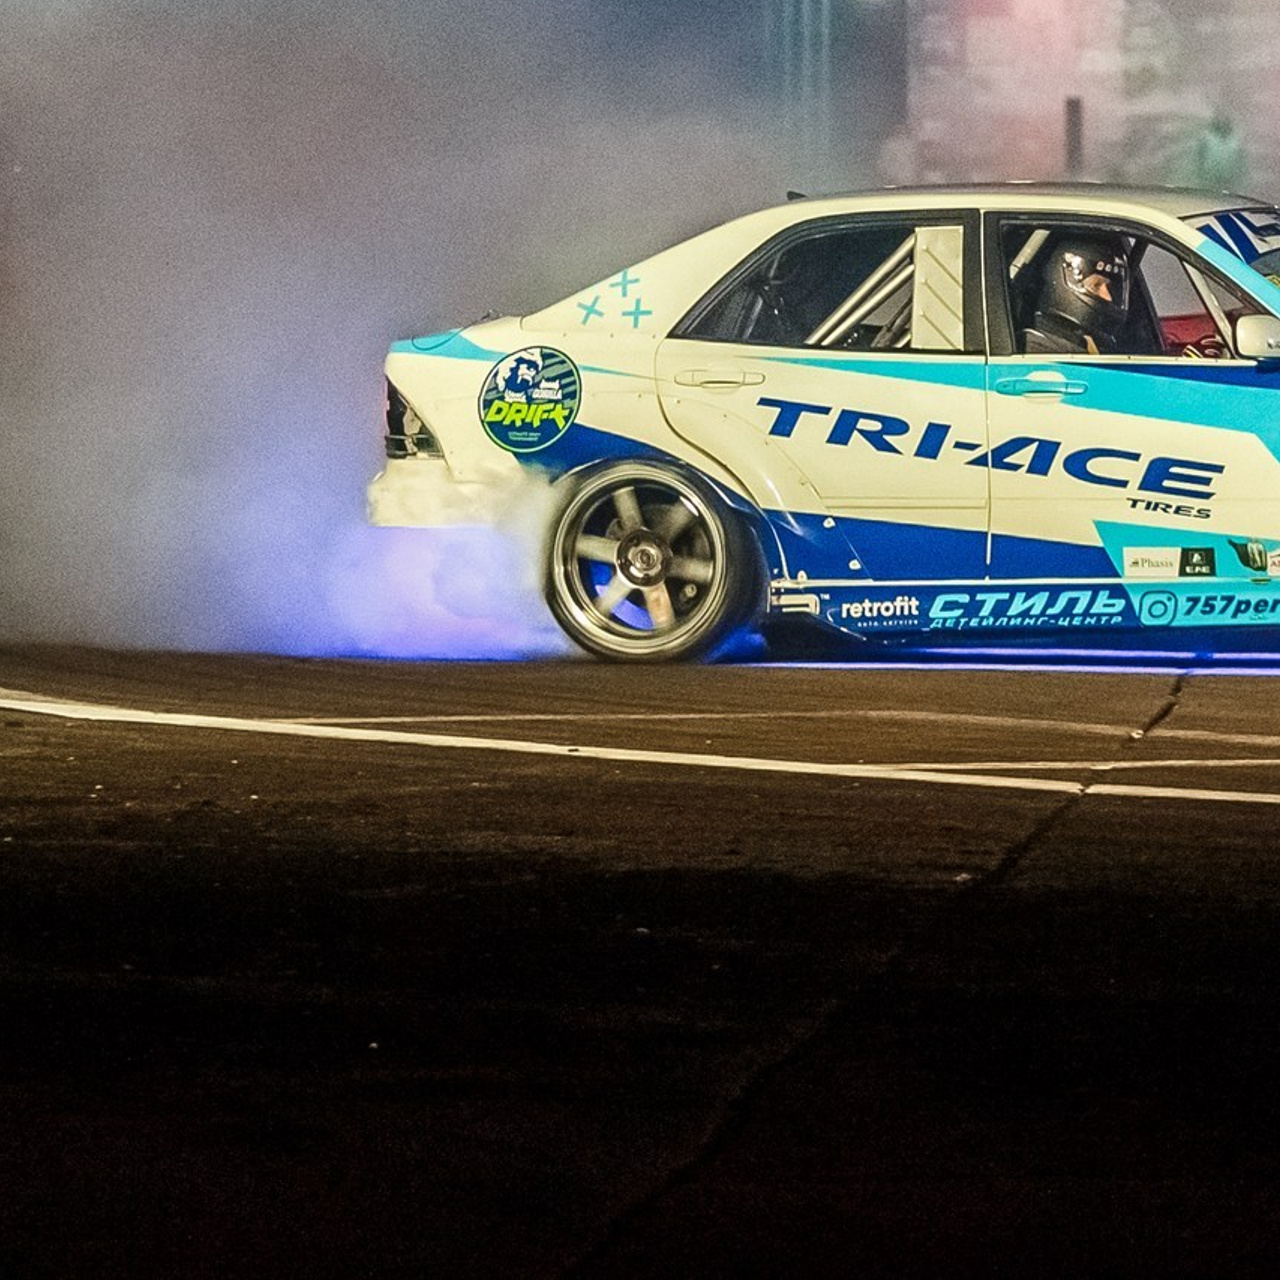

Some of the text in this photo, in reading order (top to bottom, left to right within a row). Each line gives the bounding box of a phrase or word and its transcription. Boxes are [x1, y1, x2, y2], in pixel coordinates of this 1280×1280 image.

[483, 399, 570, 431] DRIFT
[756, 396, 1226, 500] TRI-ACE
[1125, 497, 1213, 520] TIRES
[841, 595, 920, 619] retrofit
[928, 590, 1127, 619] СТИЛЬ
